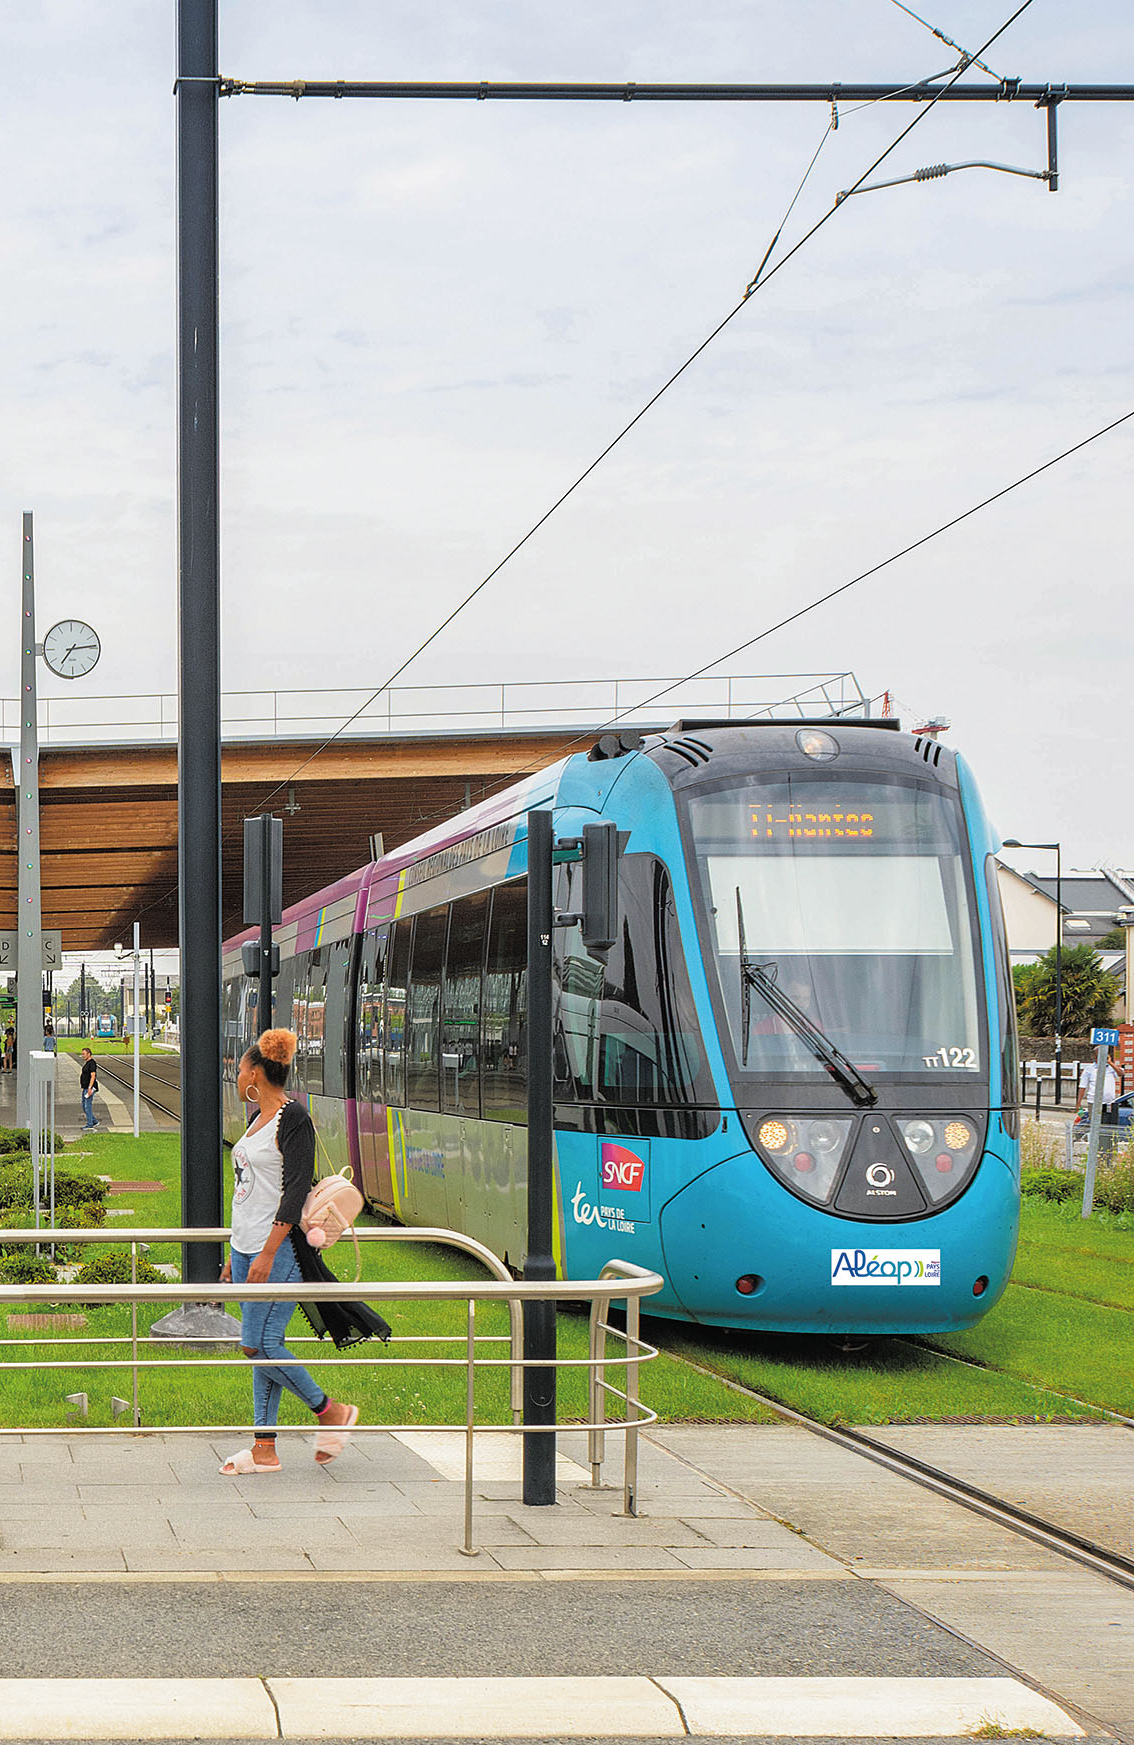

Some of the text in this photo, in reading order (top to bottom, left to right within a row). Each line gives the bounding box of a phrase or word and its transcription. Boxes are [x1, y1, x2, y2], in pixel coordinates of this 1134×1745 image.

[2, 941, 10, 951] D
[45, 941, 53, 951] C
[1096, 1031, 1115, 1043] 311
[603, 1161, 643, 1185] SNCF
[571, 1181, 608, 1228] ter
[600, 1206, 626, 1220] PAYS DE
[608, 1219, 636, 1234] LA LOIRE
[832, 1249, 913, 1285] Aléop
